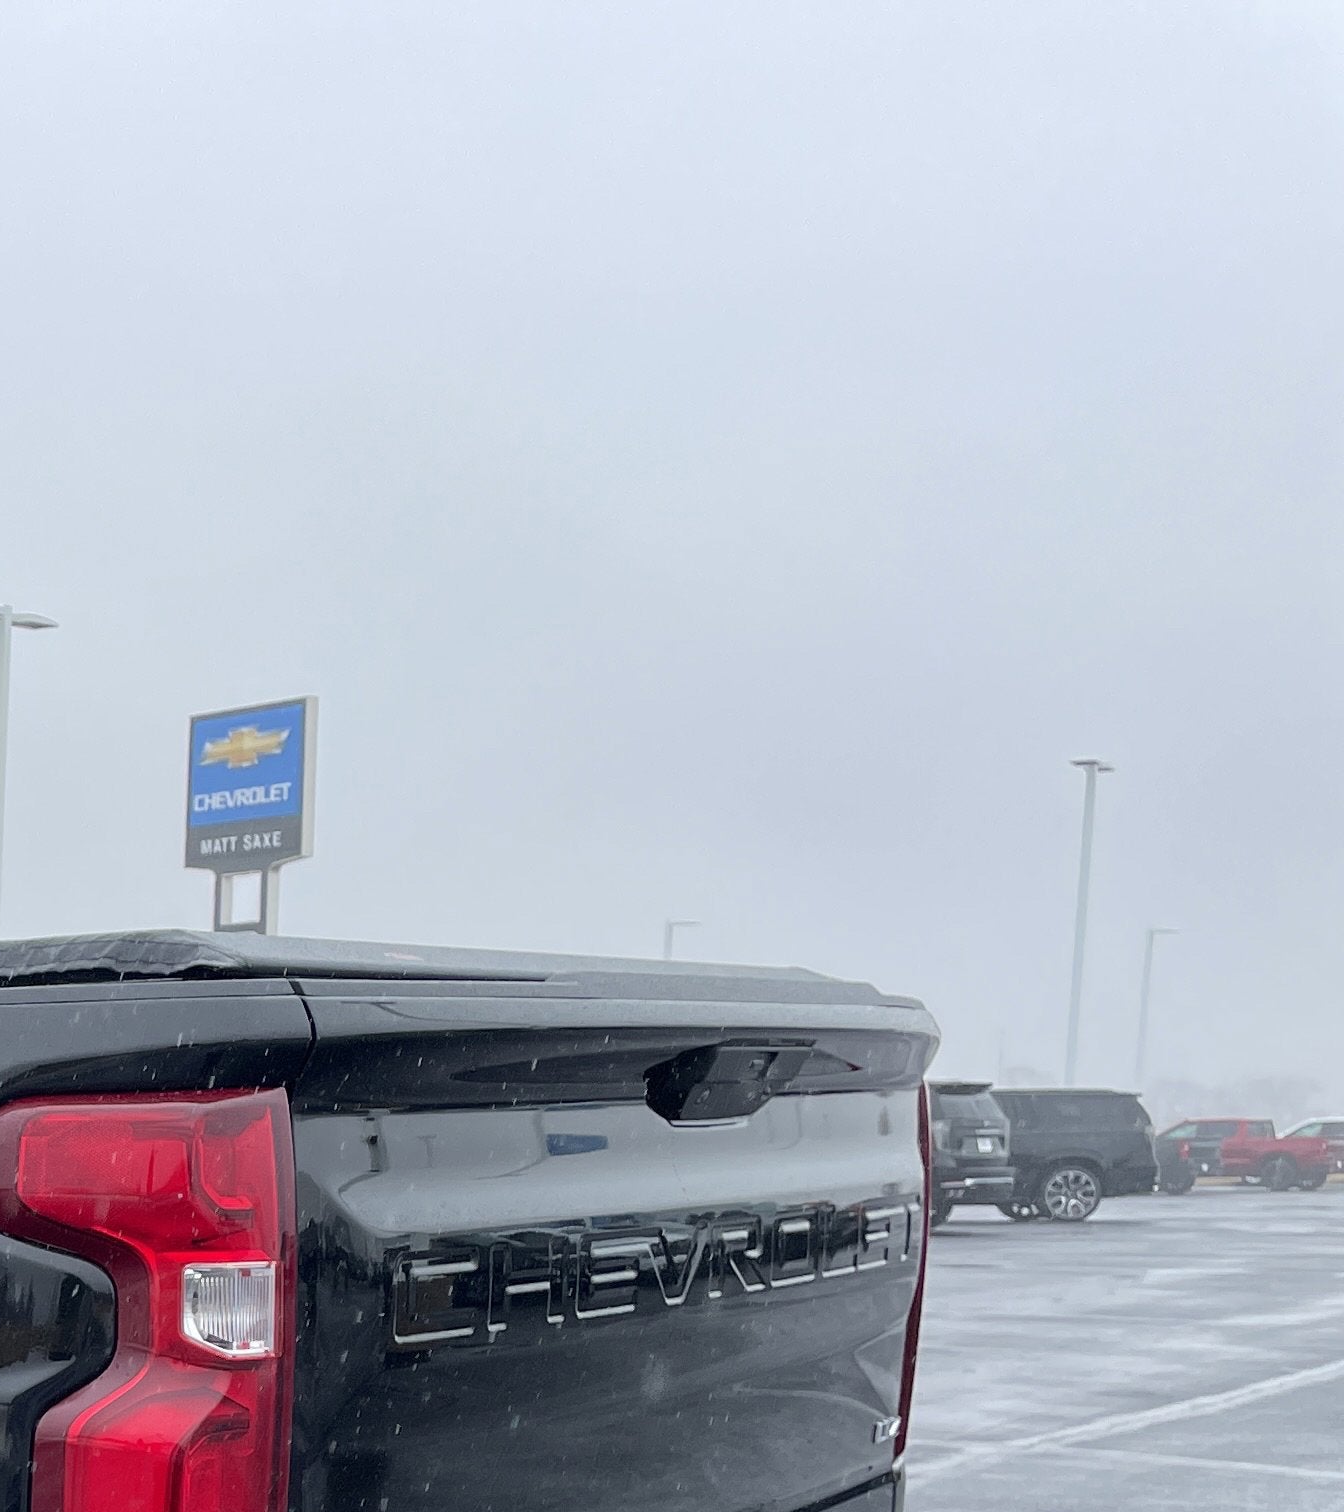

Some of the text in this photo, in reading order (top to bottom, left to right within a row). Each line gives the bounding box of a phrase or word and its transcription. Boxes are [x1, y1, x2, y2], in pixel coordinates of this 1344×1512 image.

[193, 782, 292, 812] CHEVROLET
[200, 830, 282, 855] MATT SAXE
[392, 1199, 921, 1345] CHEVROLET
